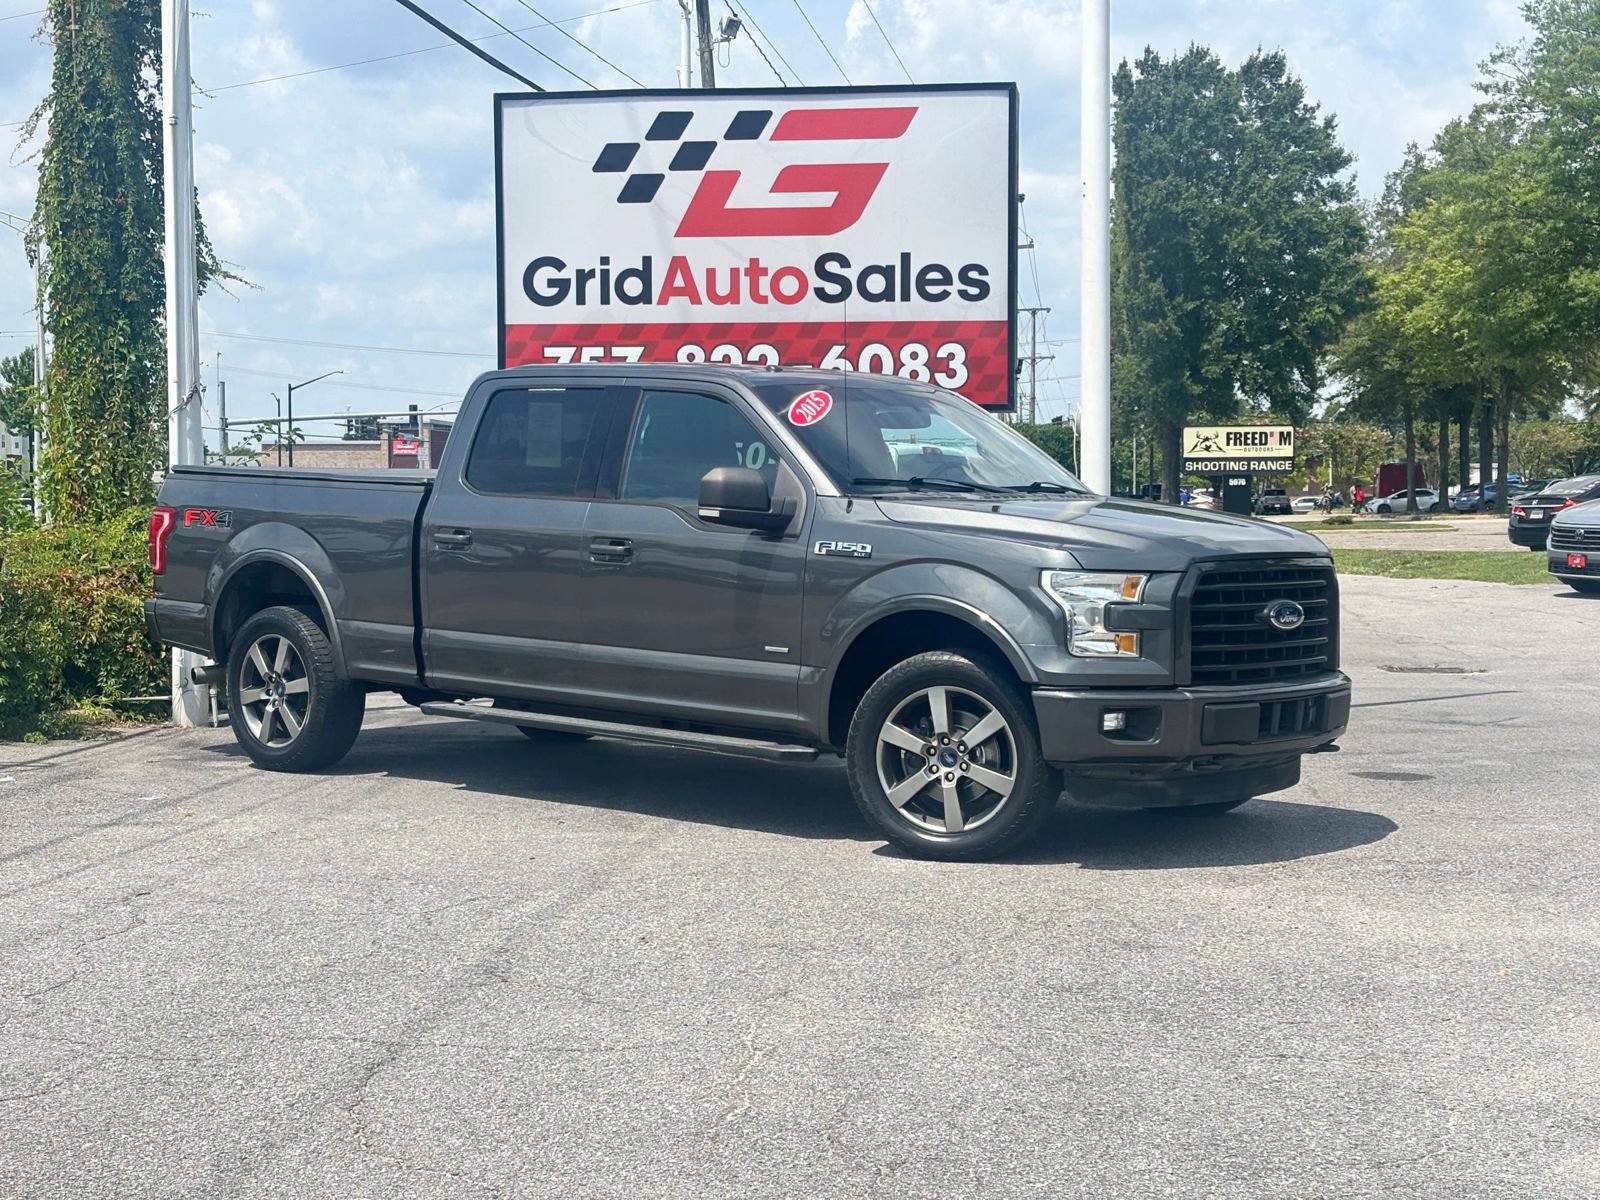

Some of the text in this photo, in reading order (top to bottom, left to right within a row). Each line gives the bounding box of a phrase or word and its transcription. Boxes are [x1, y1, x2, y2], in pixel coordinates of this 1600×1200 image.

[522, 252, 990, 307] GridAutoSales
[795, 393, 826, 423] 2015
[1226, 431, 1292, 447] FREEDM
[1185, 460, 1293, 471] SHOOTING RANGE
[183, 508, 232, 528] FX4
